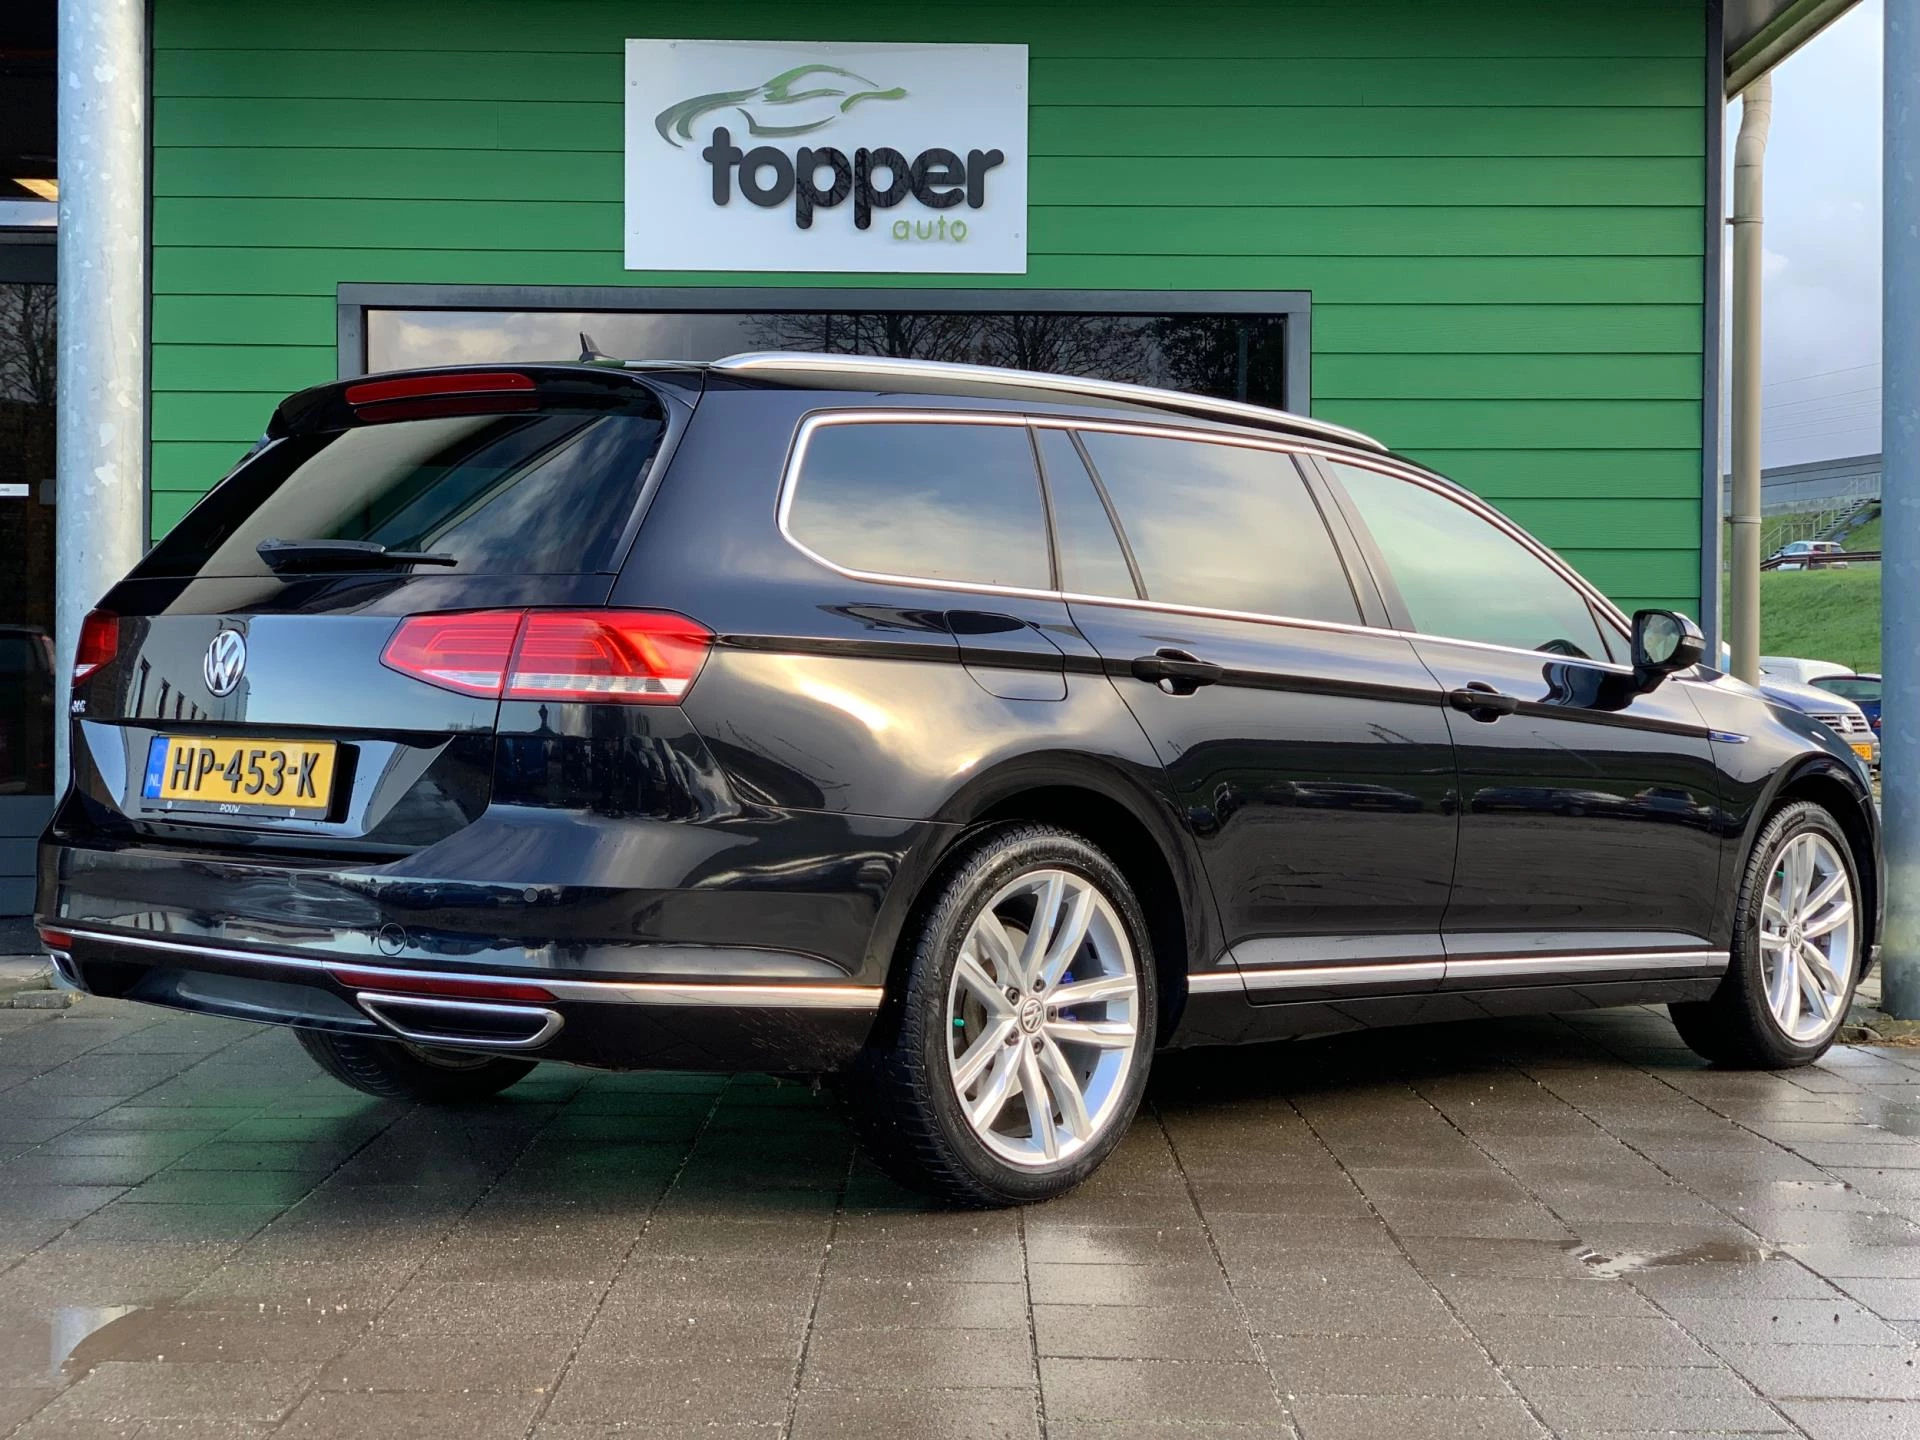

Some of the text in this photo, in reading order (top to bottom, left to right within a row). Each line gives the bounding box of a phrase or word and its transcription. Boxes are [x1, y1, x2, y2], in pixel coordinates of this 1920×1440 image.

[702, 126, 1005, 231] topper
[892, 215, 969, 242] auto
[149, 774, 161, 788] NL
[170, 746, 319, 798] HP-453-K
[219, 803, 241, 814] POUW
